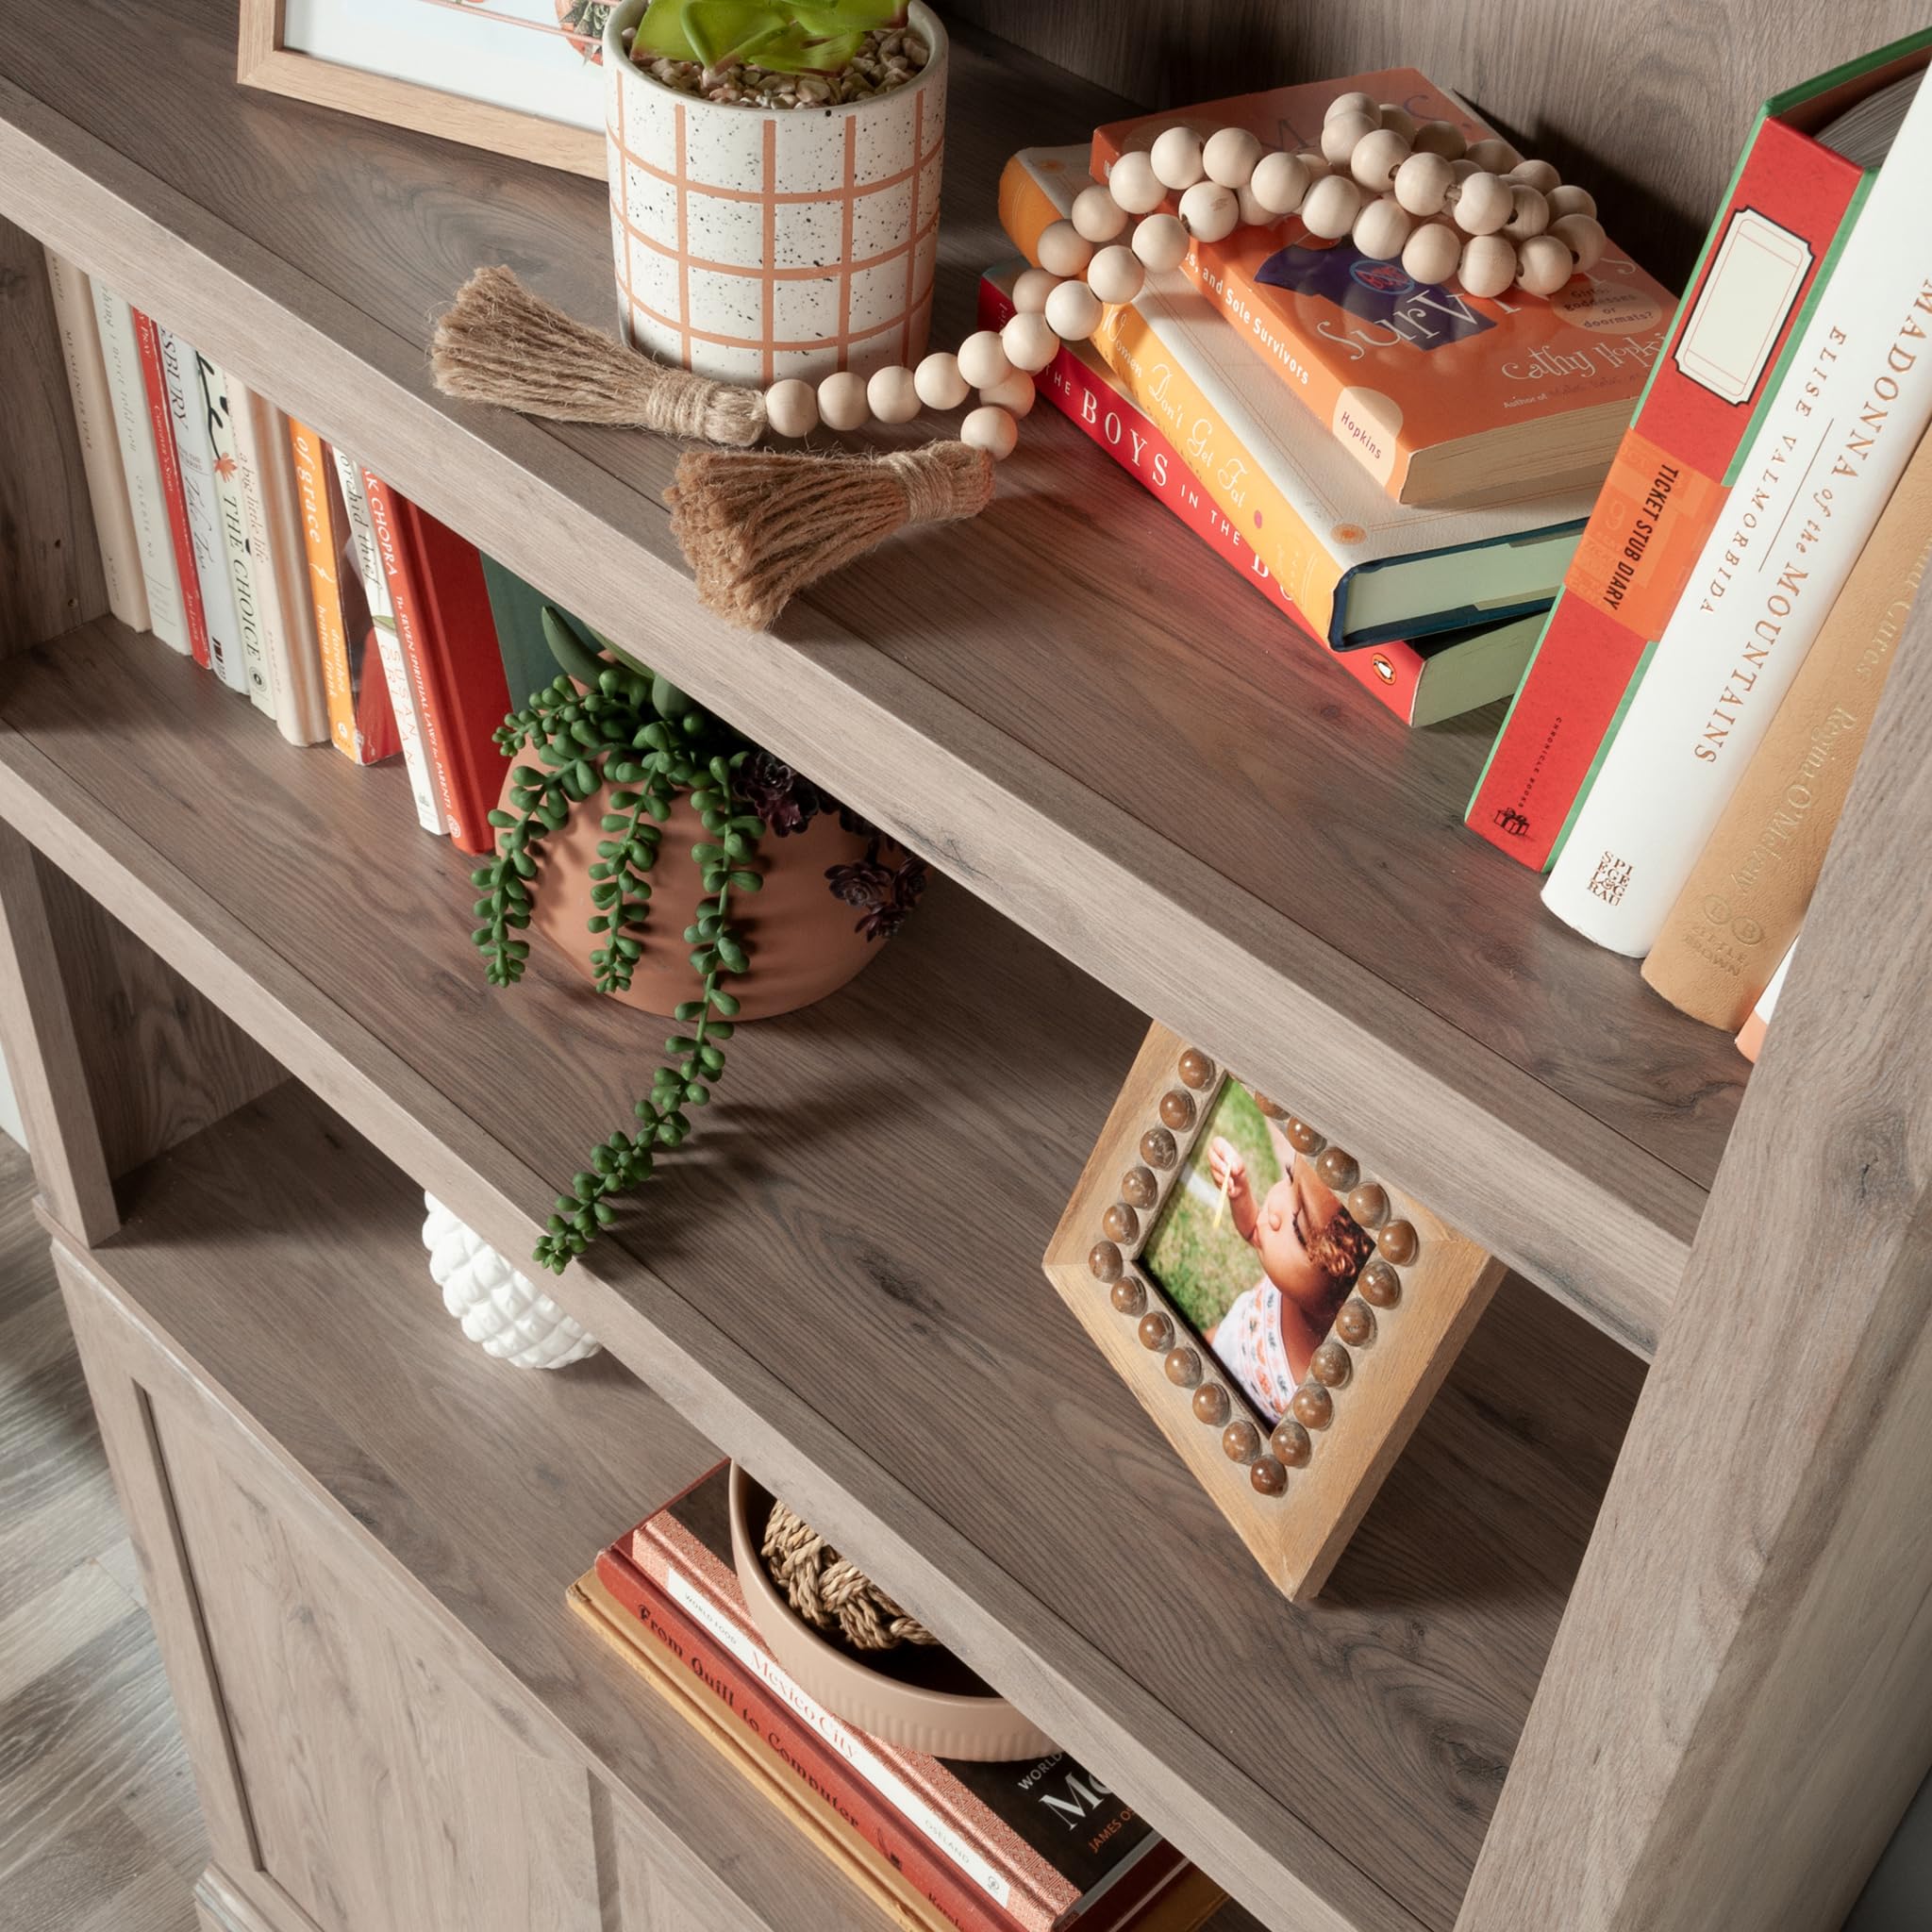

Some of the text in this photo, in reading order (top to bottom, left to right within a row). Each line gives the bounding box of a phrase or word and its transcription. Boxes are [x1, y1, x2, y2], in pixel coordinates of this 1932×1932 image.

[1203, 267, 1224, 294] and
[1225, 290, 1251, 325] Sole
[1253, 317, 1308, 385] Survivors
[1583, 311, 1654, 328] doormats?
[1602, 307, 1617, 315] or
[1502, 345, 1596, 379] Cathy
[1102, 302, 1247, 508] Women Don't Get Fat
[1341, 411, 1383, 459] Hopkins
[241, 466, 255, 492] big
[294, 437, 322, 543] of grace
[1044, 364, 1241, 545] THE BOYS IN THE
[1700, 325, 1847, 613] ELISE VALMORBIDA
[246, 494, 263, 537] little
[253, 533, 270, 563] life
[341, 455, 383, 590] orchid thief
[372, 497, 397, 576] CHOPRA
[1603, 463, 1679, 610] TICKET STUB DIARY
[1694, 279, 1932, 762] MADONNA of the MOUNTAINS
[224, 495, 261, 661] THE CHOICE
[317, 604, 339, 698] benton frank
[331, 628, 345, 693] dorothea
[400, 611, 415, 650] SEVEN
[409, 650, 428, 709] SPIRITUAL
[425, 713, 438, 748] LAWS
[436, 761, 453, 810] PARENTS
[1800, 706, 1857, 778] Regina
[1518, 716, 1563, 808] CHRONICLE BOOKS
[1587, 881, 1621, 907] RAU
[1602, 851, 1633, 875] SPI
[686, 1593, 737, 1644] WORLD FOOD
[638, 1604, 859, 1827] From Quill to Computer
[751, 1651, 856, 1759] Mexico City
[1017, 1751, 1064, 1790] WORLD
[1089, 1818, 1122, 1854] JAMES
